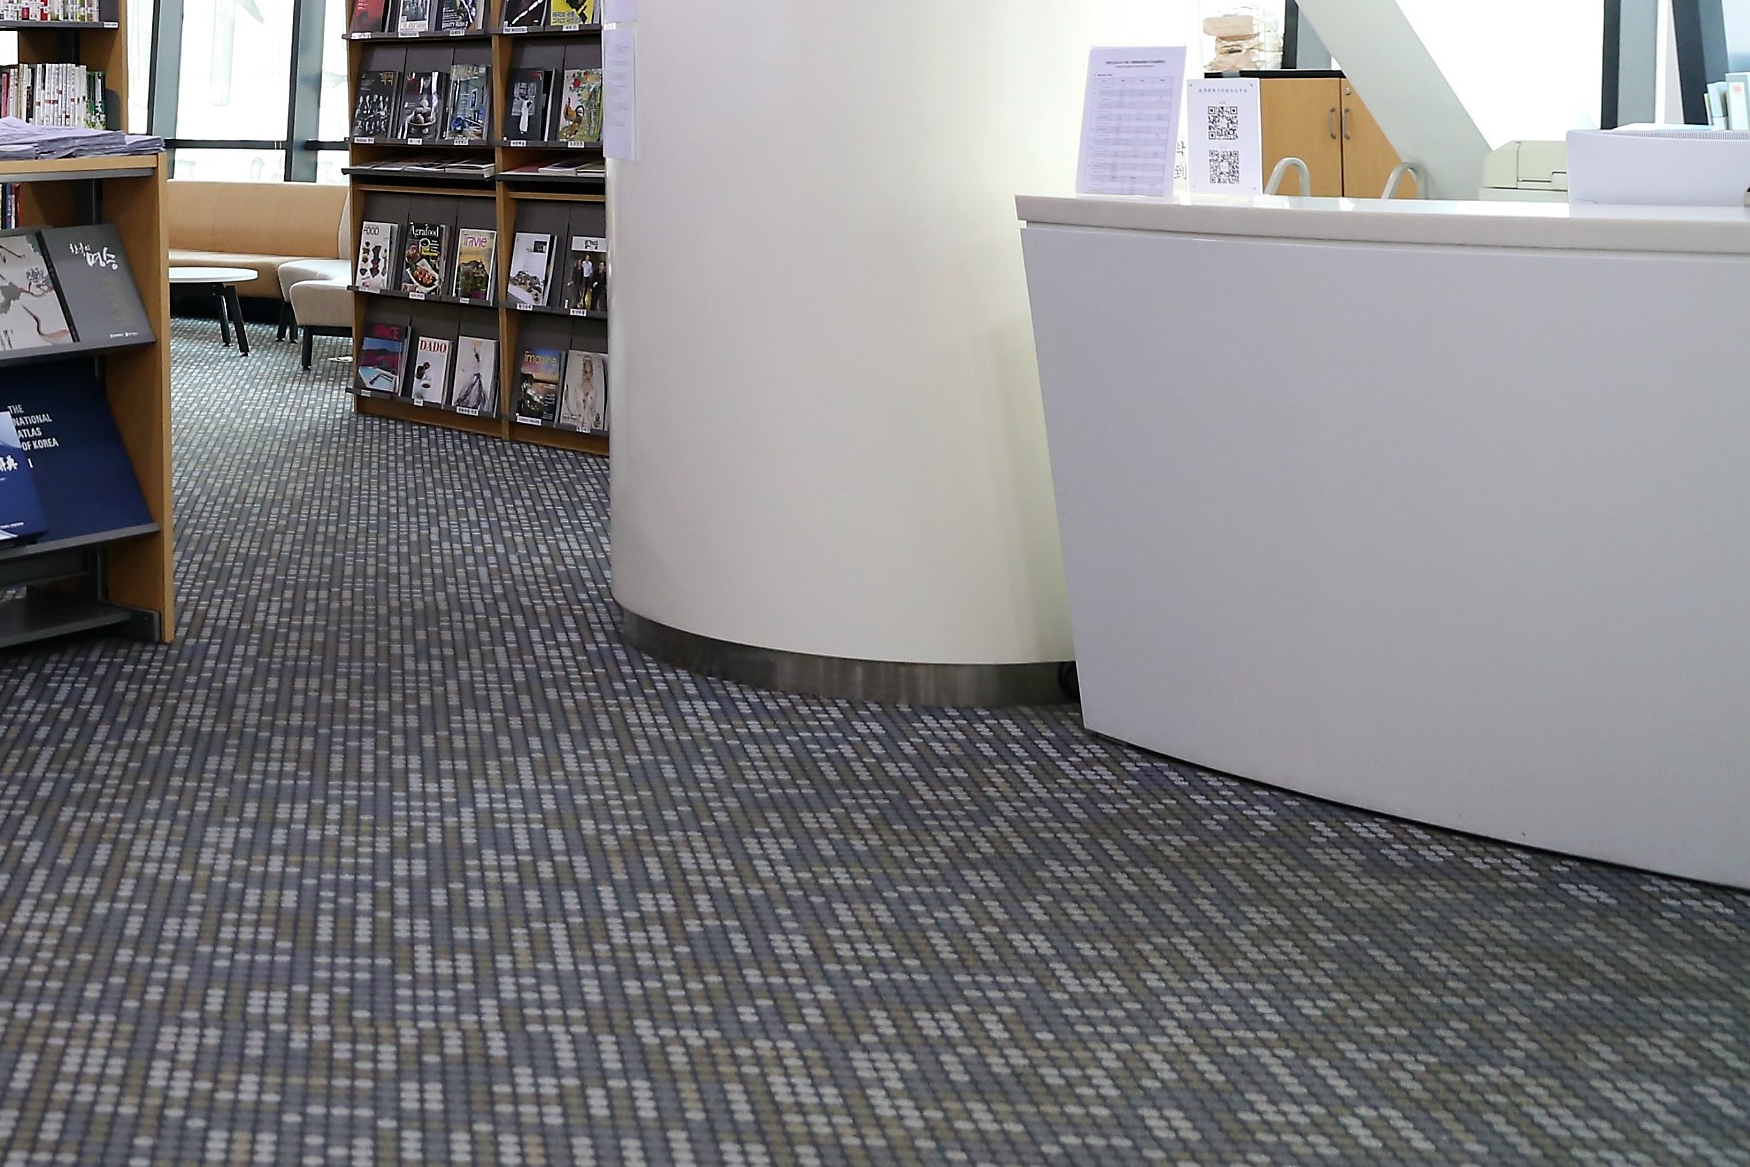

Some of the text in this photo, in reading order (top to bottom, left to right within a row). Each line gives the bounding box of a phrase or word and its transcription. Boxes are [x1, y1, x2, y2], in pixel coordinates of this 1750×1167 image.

[419, 340, 447, 353] DADO
[7, 404, 24, 415] THE
[12, 413, 53, 427] NATIONAL
[17, 427, 42, 439] ATLAS
[21, 437, 59, 451] OF KOREA
